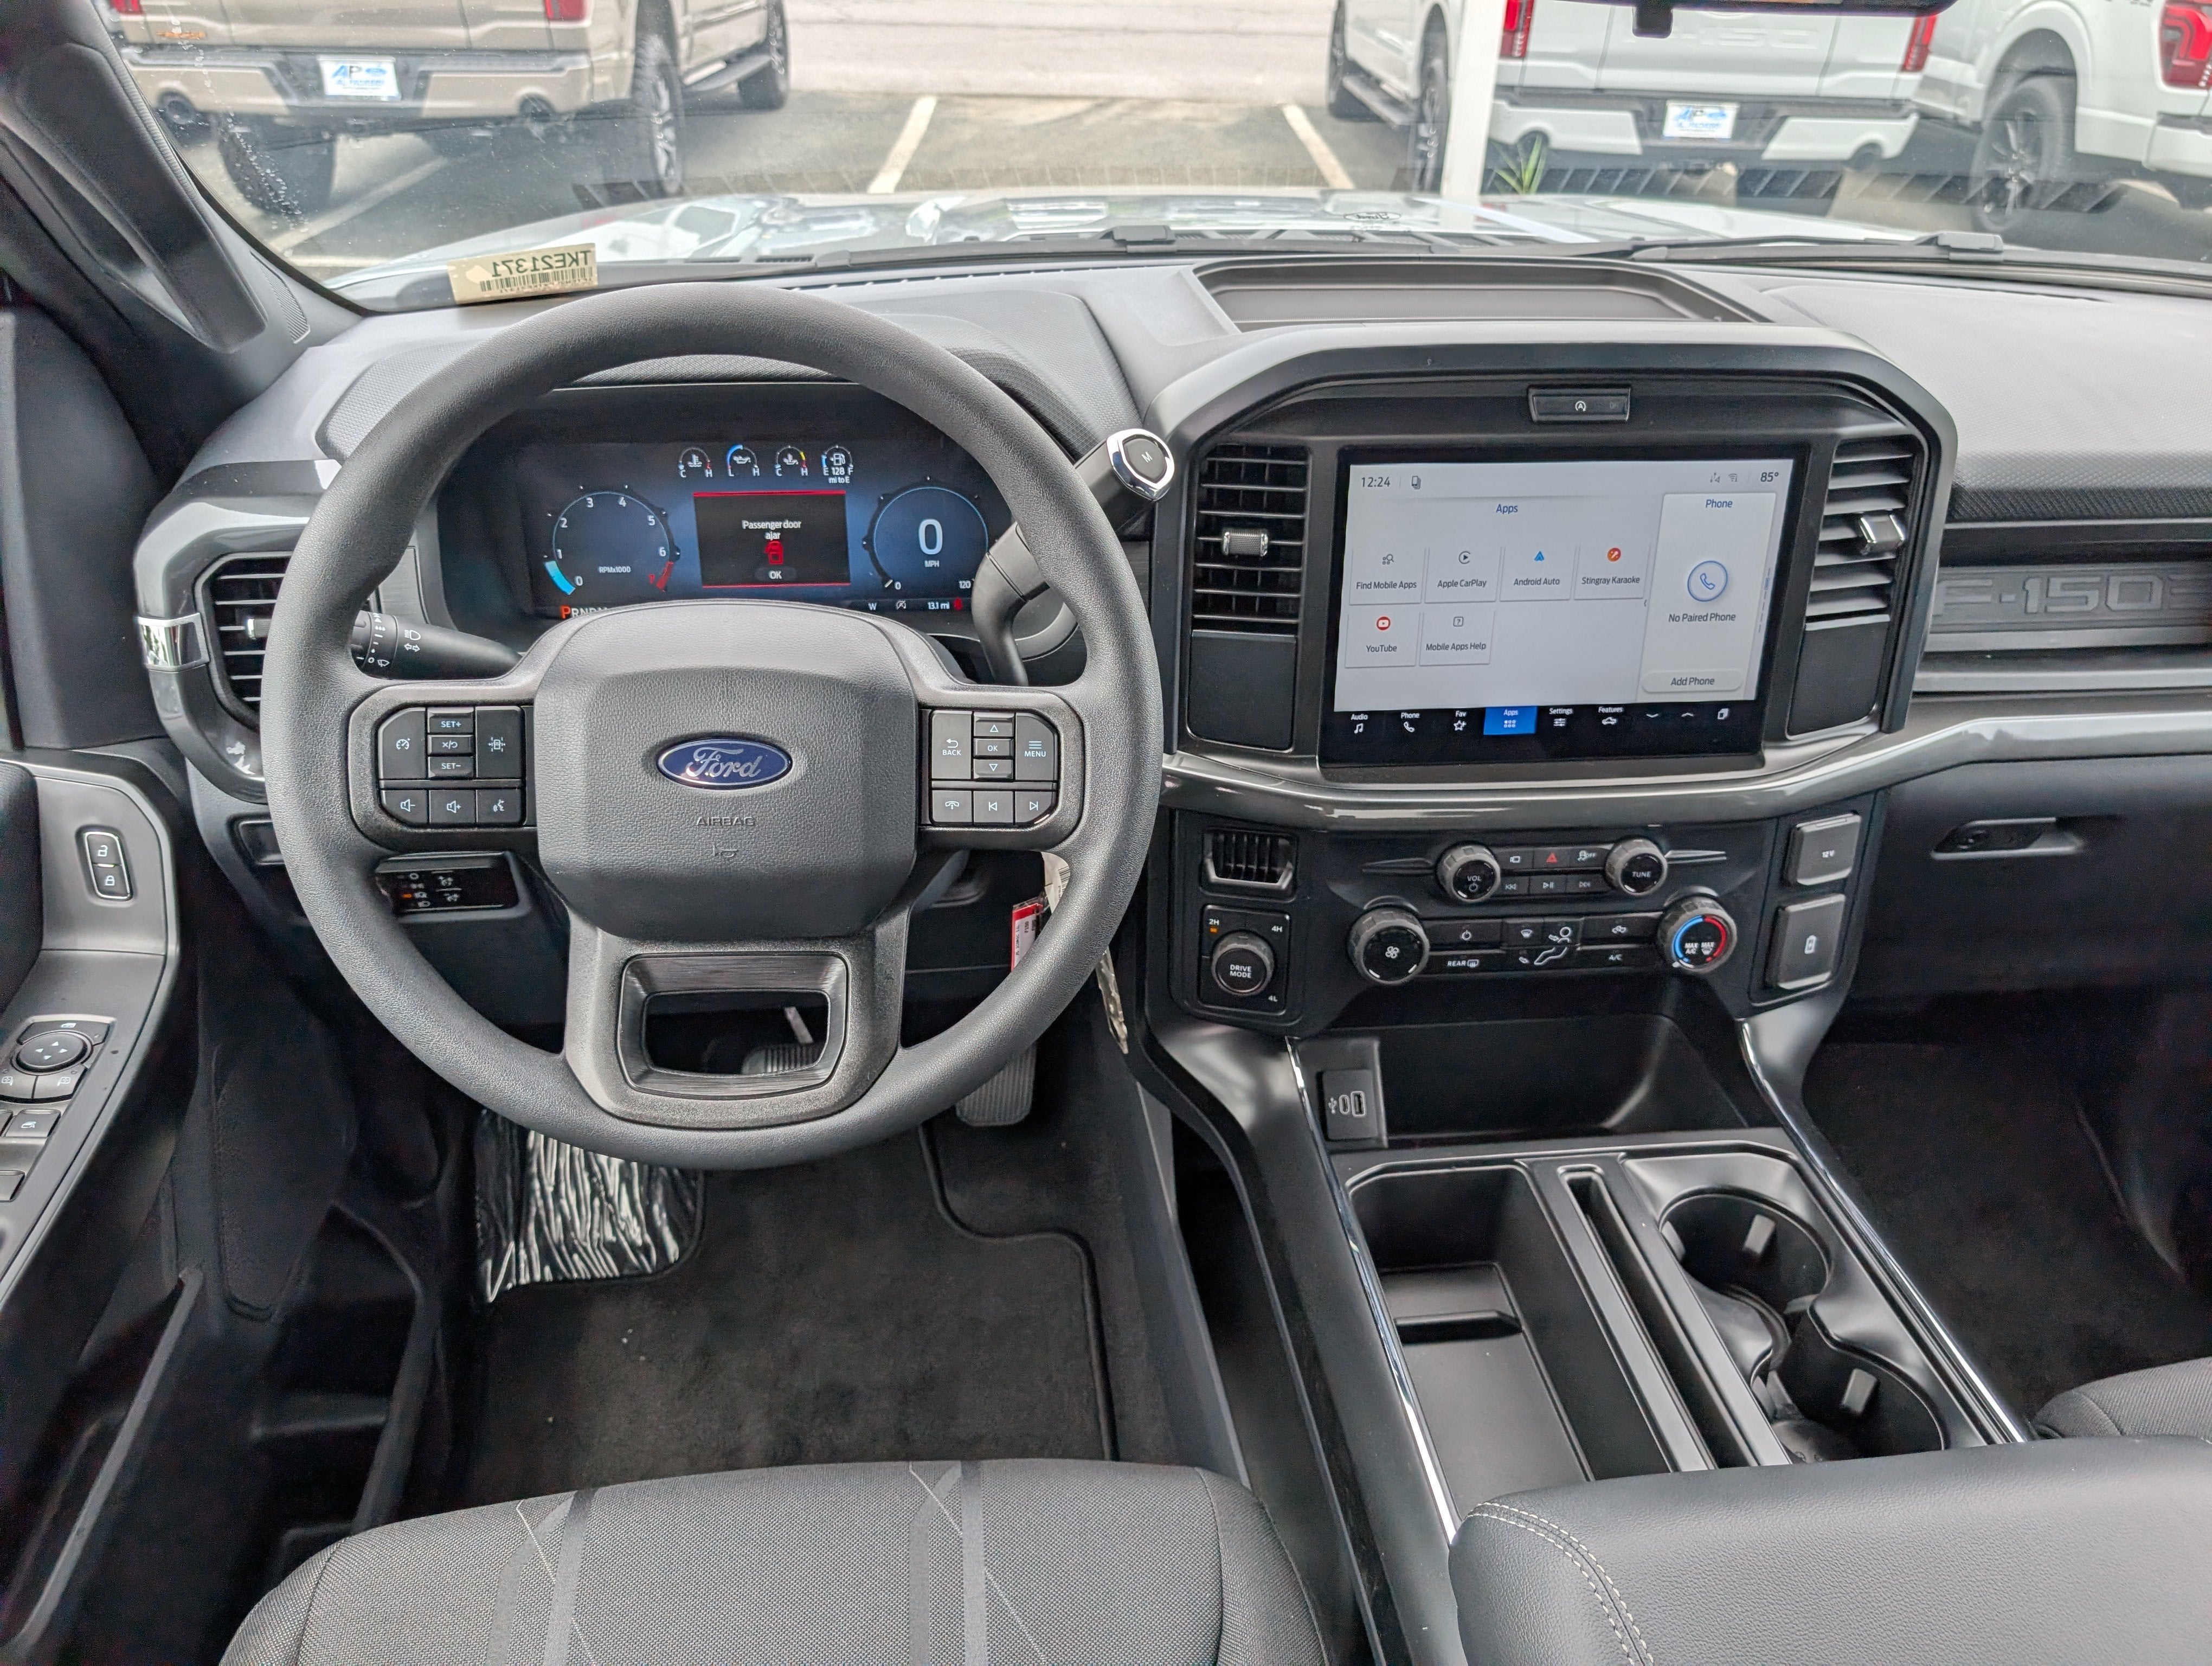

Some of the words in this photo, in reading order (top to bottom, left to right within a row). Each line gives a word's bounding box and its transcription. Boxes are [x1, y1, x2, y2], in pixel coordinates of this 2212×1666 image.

[680, 469, 687, 478] C
[705, 469, 713, 478] H
[728, 469, 734, 477] L
[753, 468, 760, 476] H
[775, 468, 782, 477] C
[801, 468, 808, 476] H
[823, 467, 829, 476] E
[831, 466, 845, 476] 128
[847, 467, 854, 476] F
[1361, 476, 1391, 488] 12:24
[1760, 471, 1779, 483] 85°
[586, 497, 594, 508] 3
[619, 496, 626, 507] 4
[1705, 498, 1733, 509] Phone
[1496, 503, 1518, 514] Apps
[560, 517, 568, 528] 2
[648, 515, 655, 526] 5
[741, 520, 782, 530] Passenger
[782, 519, 802, 529] door
[764, 531, 781, 541] ajar
[918, 518, 943, 555] 0
[556, 549, 563, 559] 1
[658, 547, 666, 557] 6
[768, 571, 782, 579] OK
[575, 575, 583, 586] 0
[895, 581, 901, 590] 0
[959, 580, 971, 589] 120
[1356, 581, 1372, 589] Find
[1373, 581, 1397, 589] Mobile
[1398, 581, 1417, 589] Apps
[1437, 579, 1458, 588] Apple
[1459, 578, 1487, 588] CarPlay
[1513, 577, 1541, 586] Android
[1542, 577, 1560, 586] Auto
[1581, 576, 1610, 586] Stingray
[1612, 575, 1640, 584] Karaoke
[1932, 574, 2164, 617] F-150
[1668, 613, 1680, 622] No
[1682, 613, 1708, 622] Paired
[1710, 612, 1736, 621] Phone
[1366, 644, 1397, 652] YouTube
[1425, 643, 1449, 651] Mobile
[1451, 643, 1468, 651] Apps
[1470, 642, 1487, 651] Help
[1670, 677, 1687, 685] Add
[1689, 677, 1715, 685] Phone
[1549, 707, 1573, 715] Settings
[440, 720, 461, 728] SET+
[685, 746, 761, 778] Ford
[696, 816, 756, 826] AIRBAG
[1230, 964, 1252, 972] DRIVE
[1230, 970, 1252, 978] MODE
